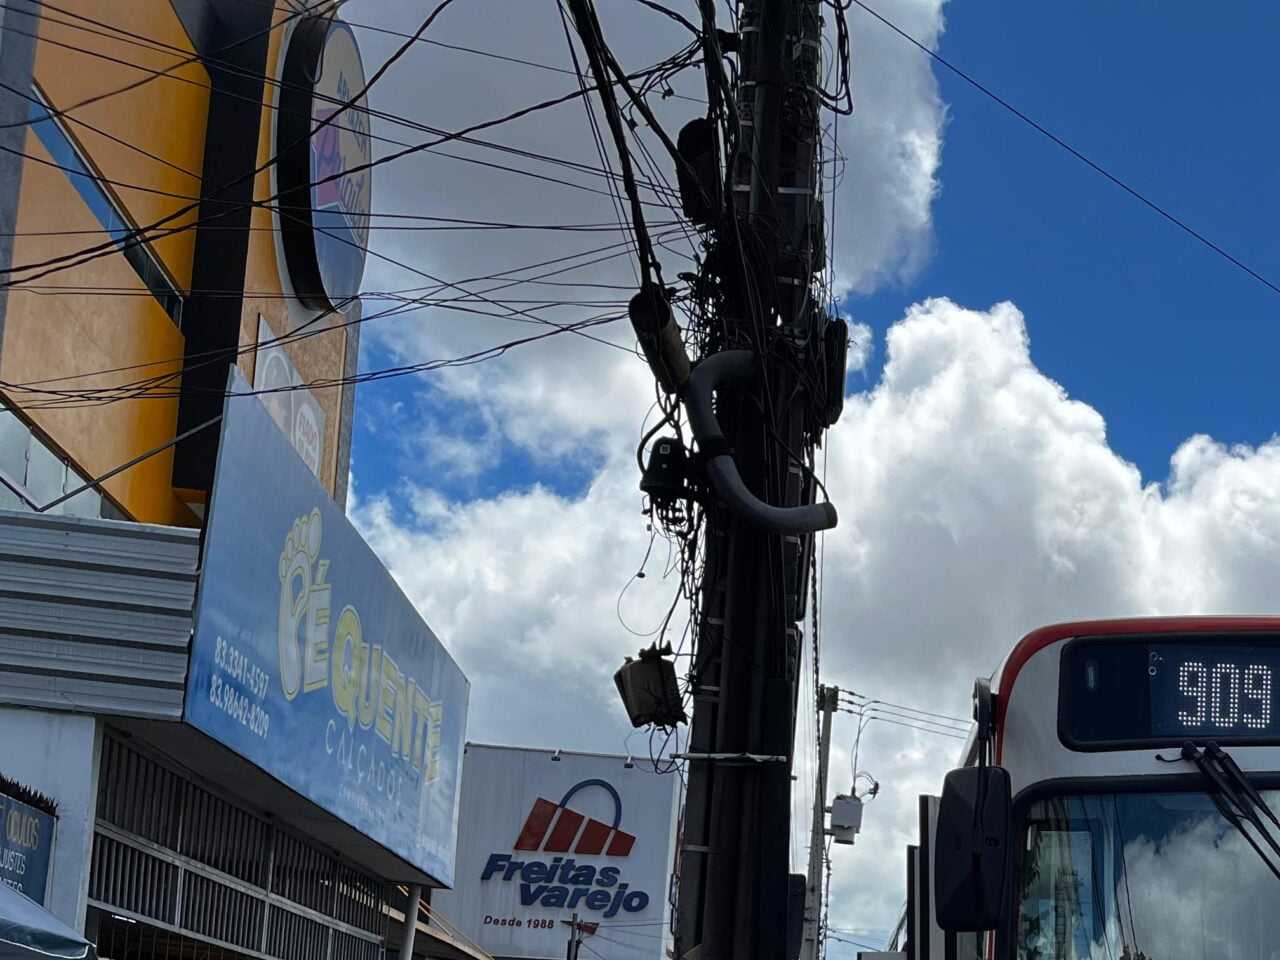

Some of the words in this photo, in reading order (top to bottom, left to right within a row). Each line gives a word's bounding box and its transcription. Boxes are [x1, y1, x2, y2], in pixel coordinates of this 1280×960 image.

[214, 636, 270, 700] 83.3341-4597
[332, 604, 444, 786] QUENTE
[1178, 661, 1271, 728] 909
[209, 674, 270, 740] 83.98642-8209
[325, 719, 403, 807] CALÇADOS
[481, 853, 621, 887] Freitas
[519, 883, 650, 918] varejo
[484, 915, 522, 927] Desde
[526, 918, 555, 929] 1988
